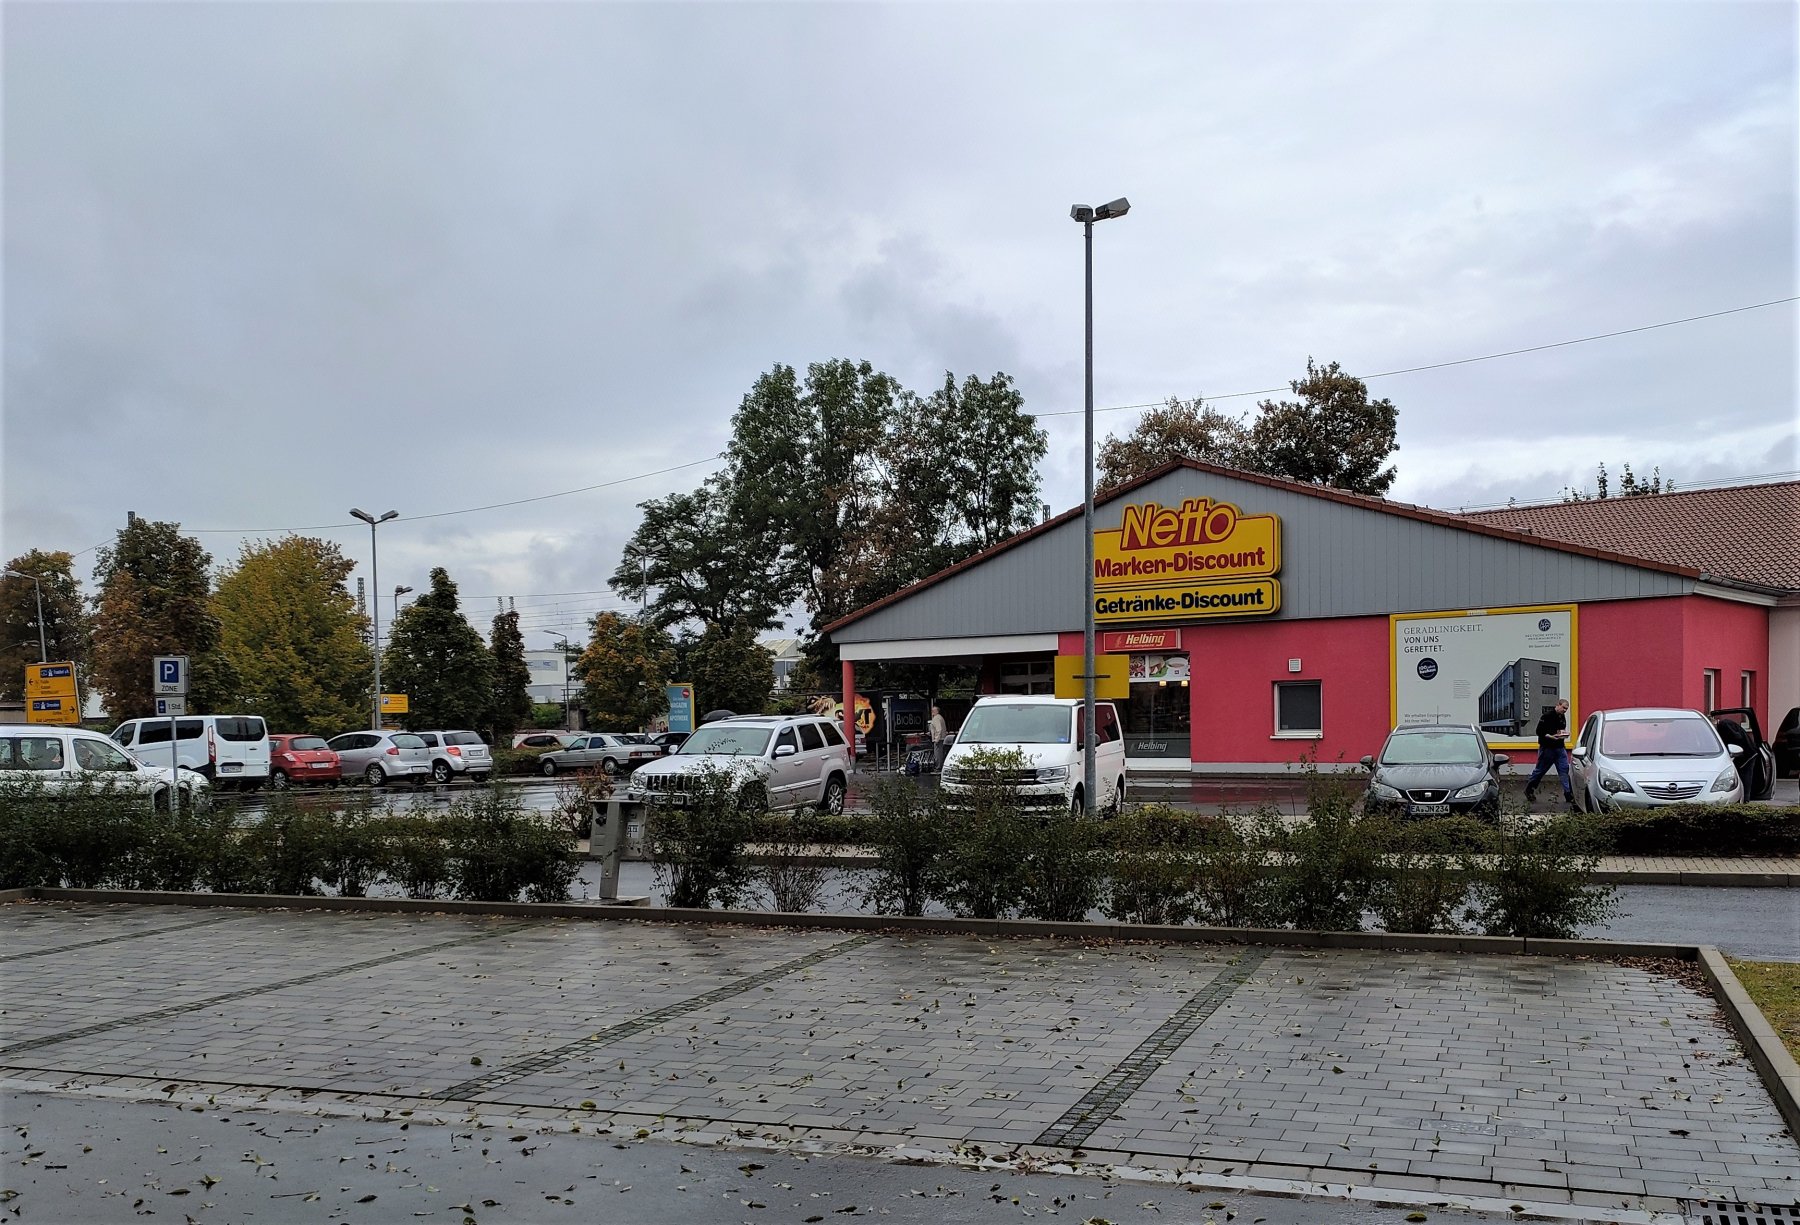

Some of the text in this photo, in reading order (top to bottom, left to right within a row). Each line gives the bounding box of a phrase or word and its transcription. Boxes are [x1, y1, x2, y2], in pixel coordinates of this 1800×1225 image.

[1121, 499, 1236, 549] Netto
[1094, 547, 1266, 578] Marken-Discount
[1095, 588, 1264, 614] Getränke-Discount
[1403, 624, 1484, 635] GERADLINIGKEIT.
[1125, 632, 1166, 647] Helbing
[1404, 635, 1440, 644] VON UNS
[1404, 645, 1445, 653] GERETTET.
[164, 663, 175, 680] P
[161, 684, 179, 692] ZONE
[1137, 741, 1168, 752] Helbing
[1411, 805, 1421, 813] EA
